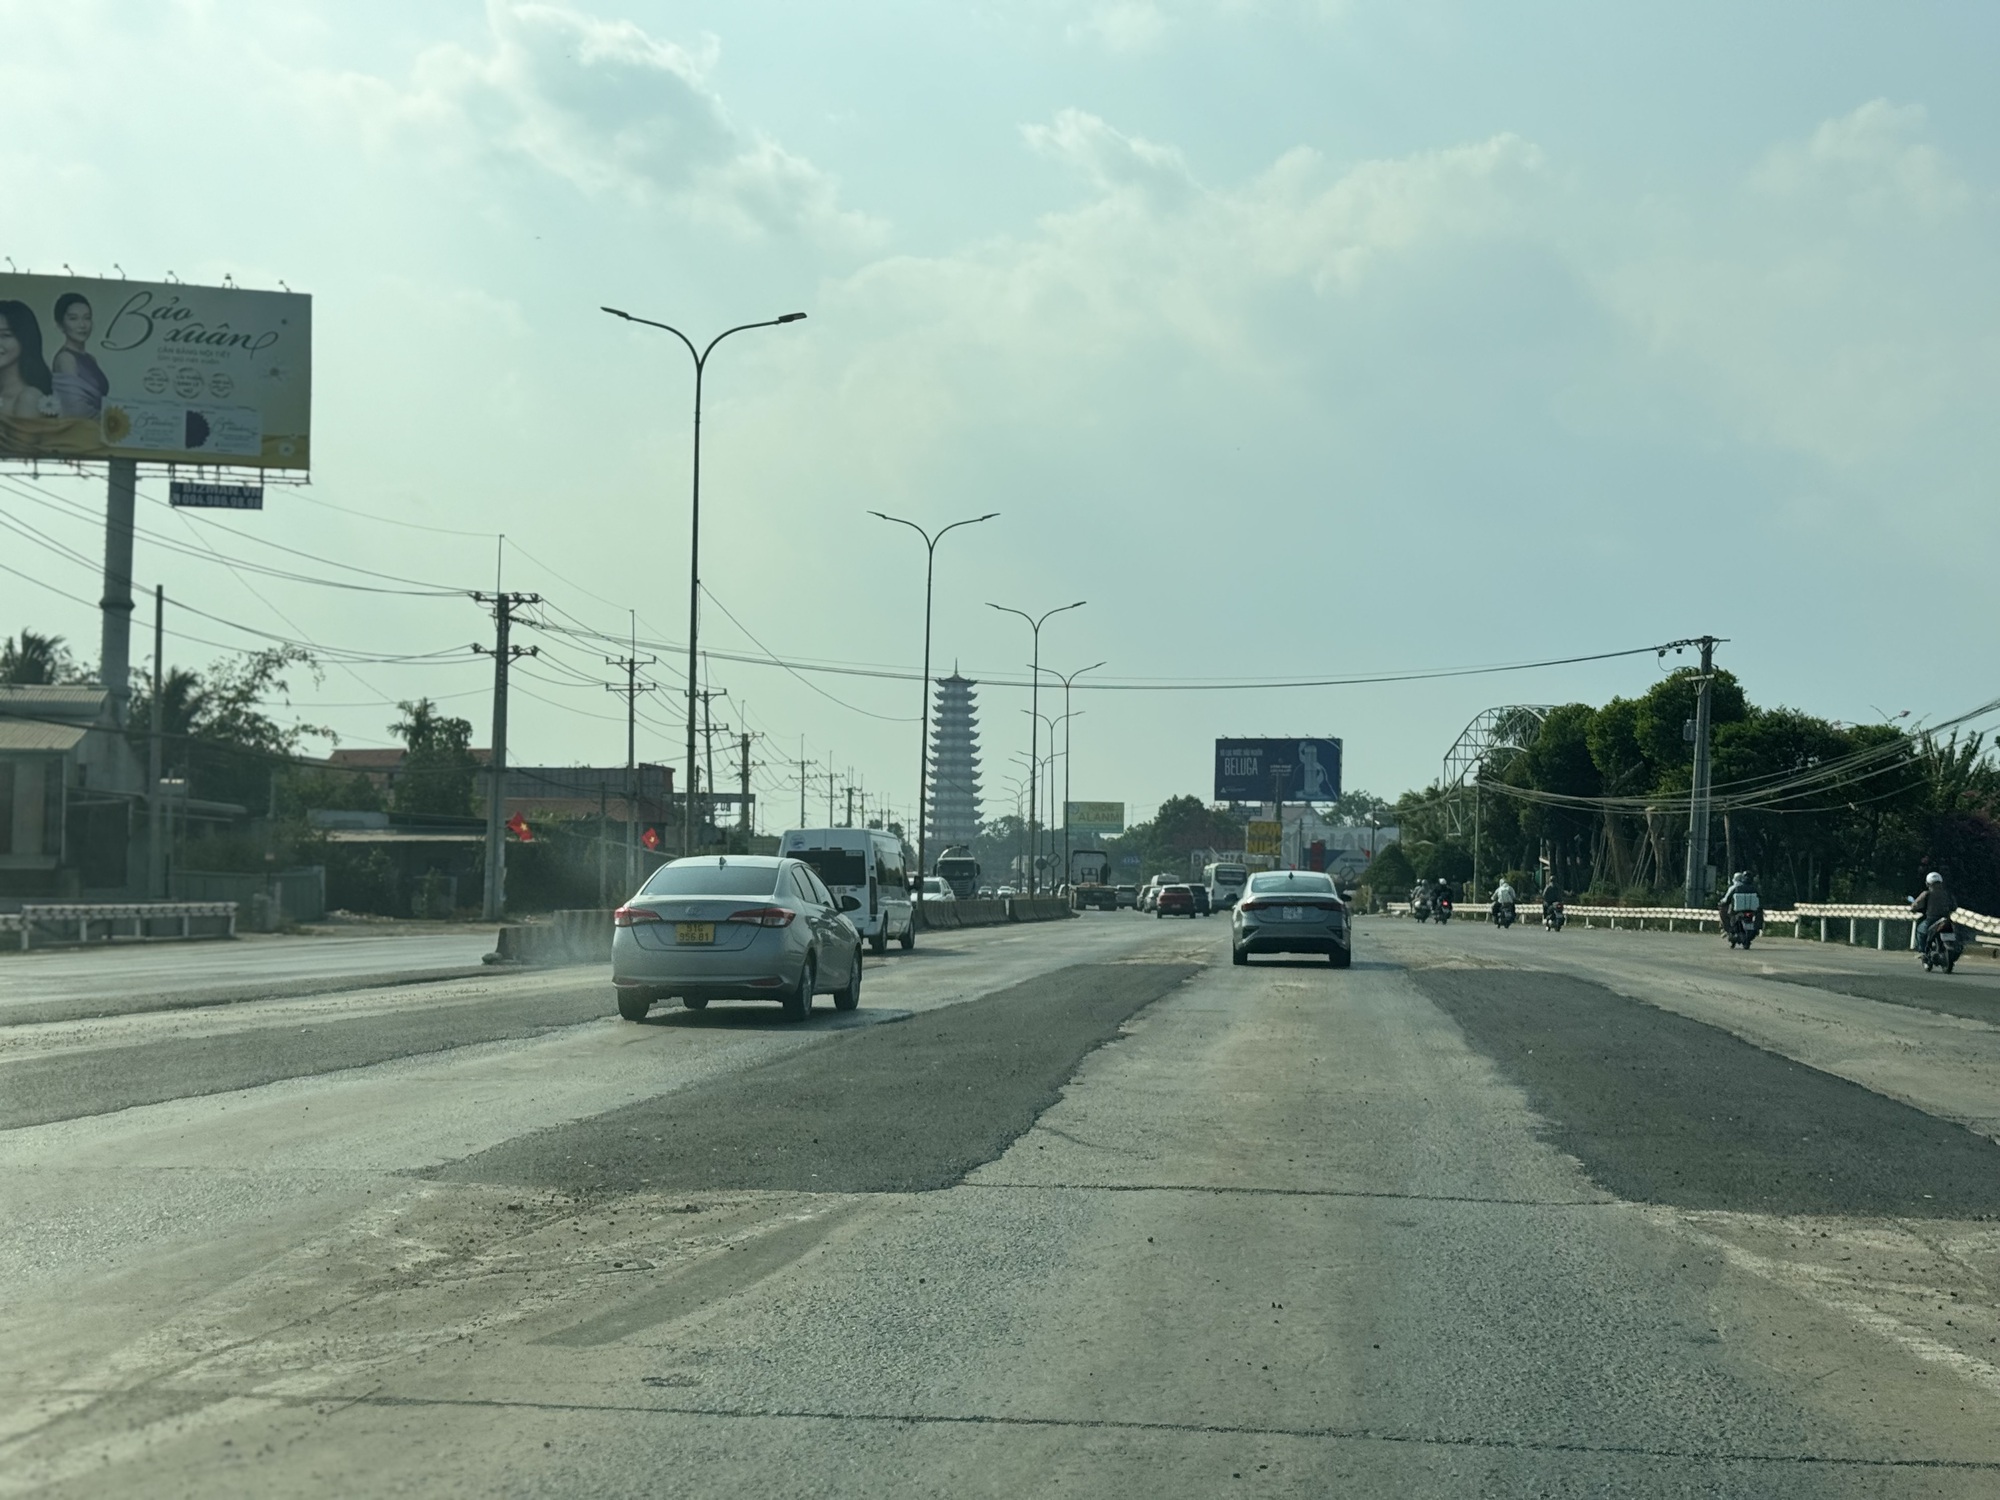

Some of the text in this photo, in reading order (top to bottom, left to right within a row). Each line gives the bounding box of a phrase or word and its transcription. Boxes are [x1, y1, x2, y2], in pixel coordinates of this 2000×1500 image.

[101, 291, 194, 351] Bảo
[163, 322, 279, 360] xuân
[1224, 757, 1259, 776] BELUGA
